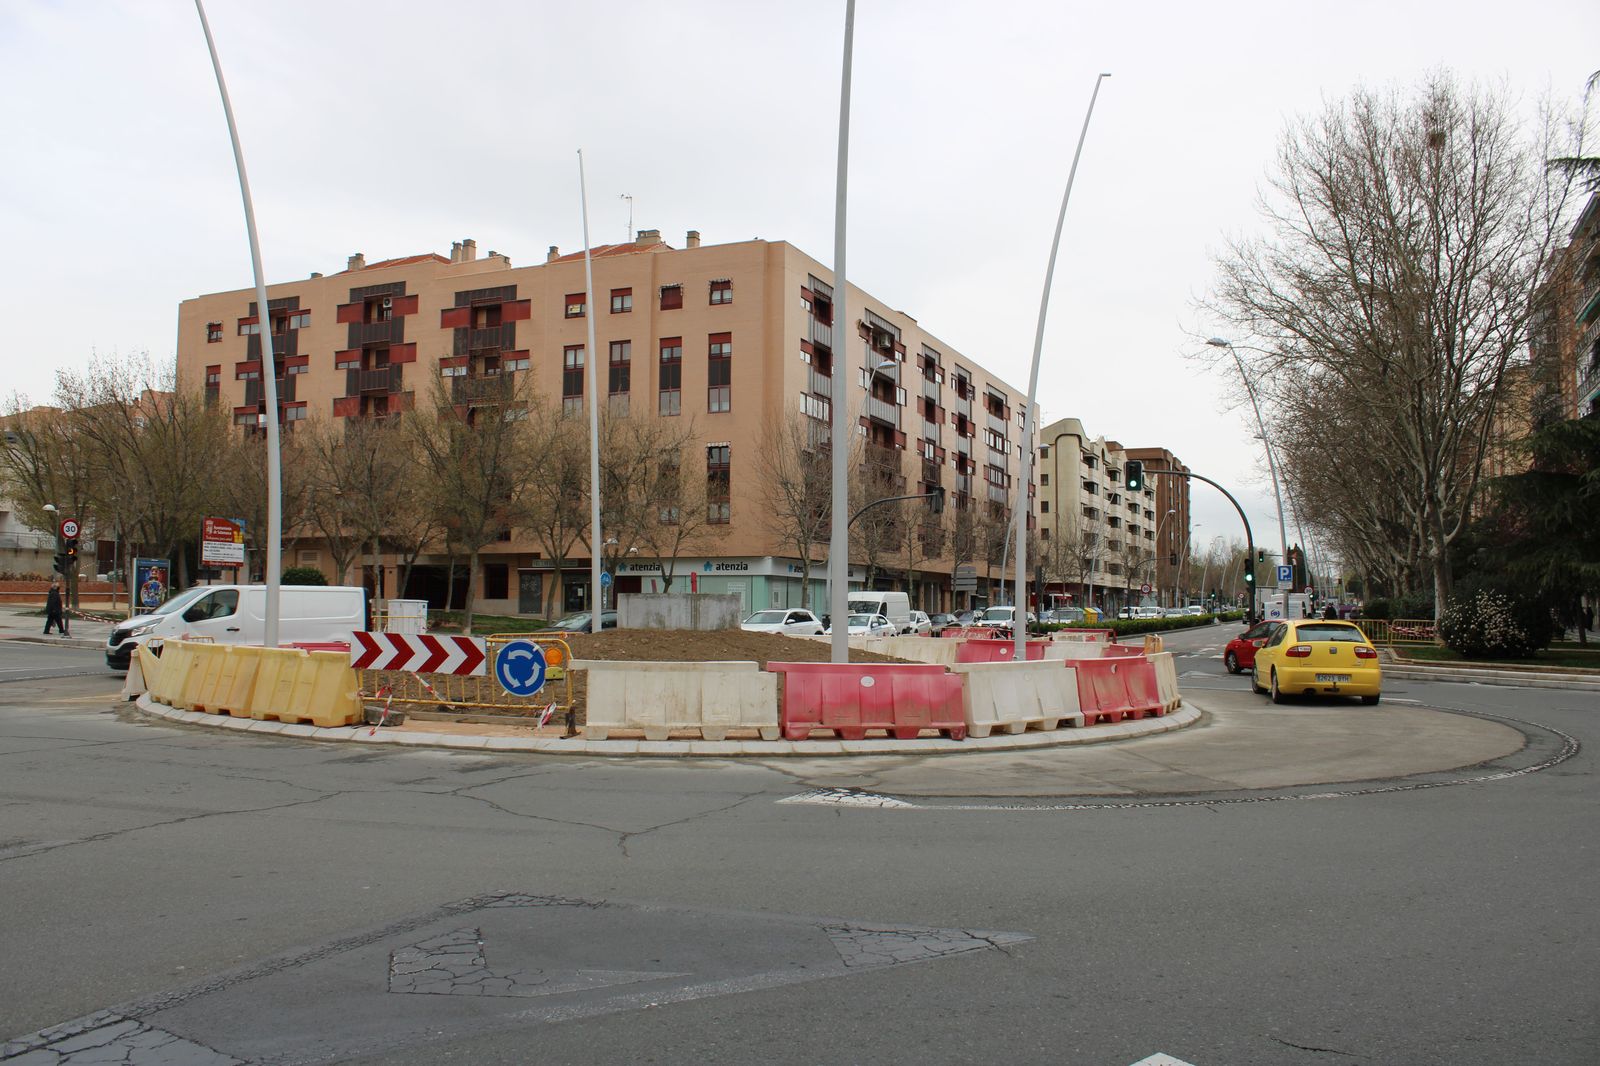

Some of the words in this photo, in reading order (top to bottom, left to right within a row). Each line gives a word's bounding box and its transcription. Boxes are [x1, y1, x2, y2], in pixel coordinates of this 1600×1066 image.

[65, 525, 76, 533] 30
[630, 562, 661, 572] atenzia
[715, 561, 748, 571] atenzia
[1281, 567, 1290, 580] P
